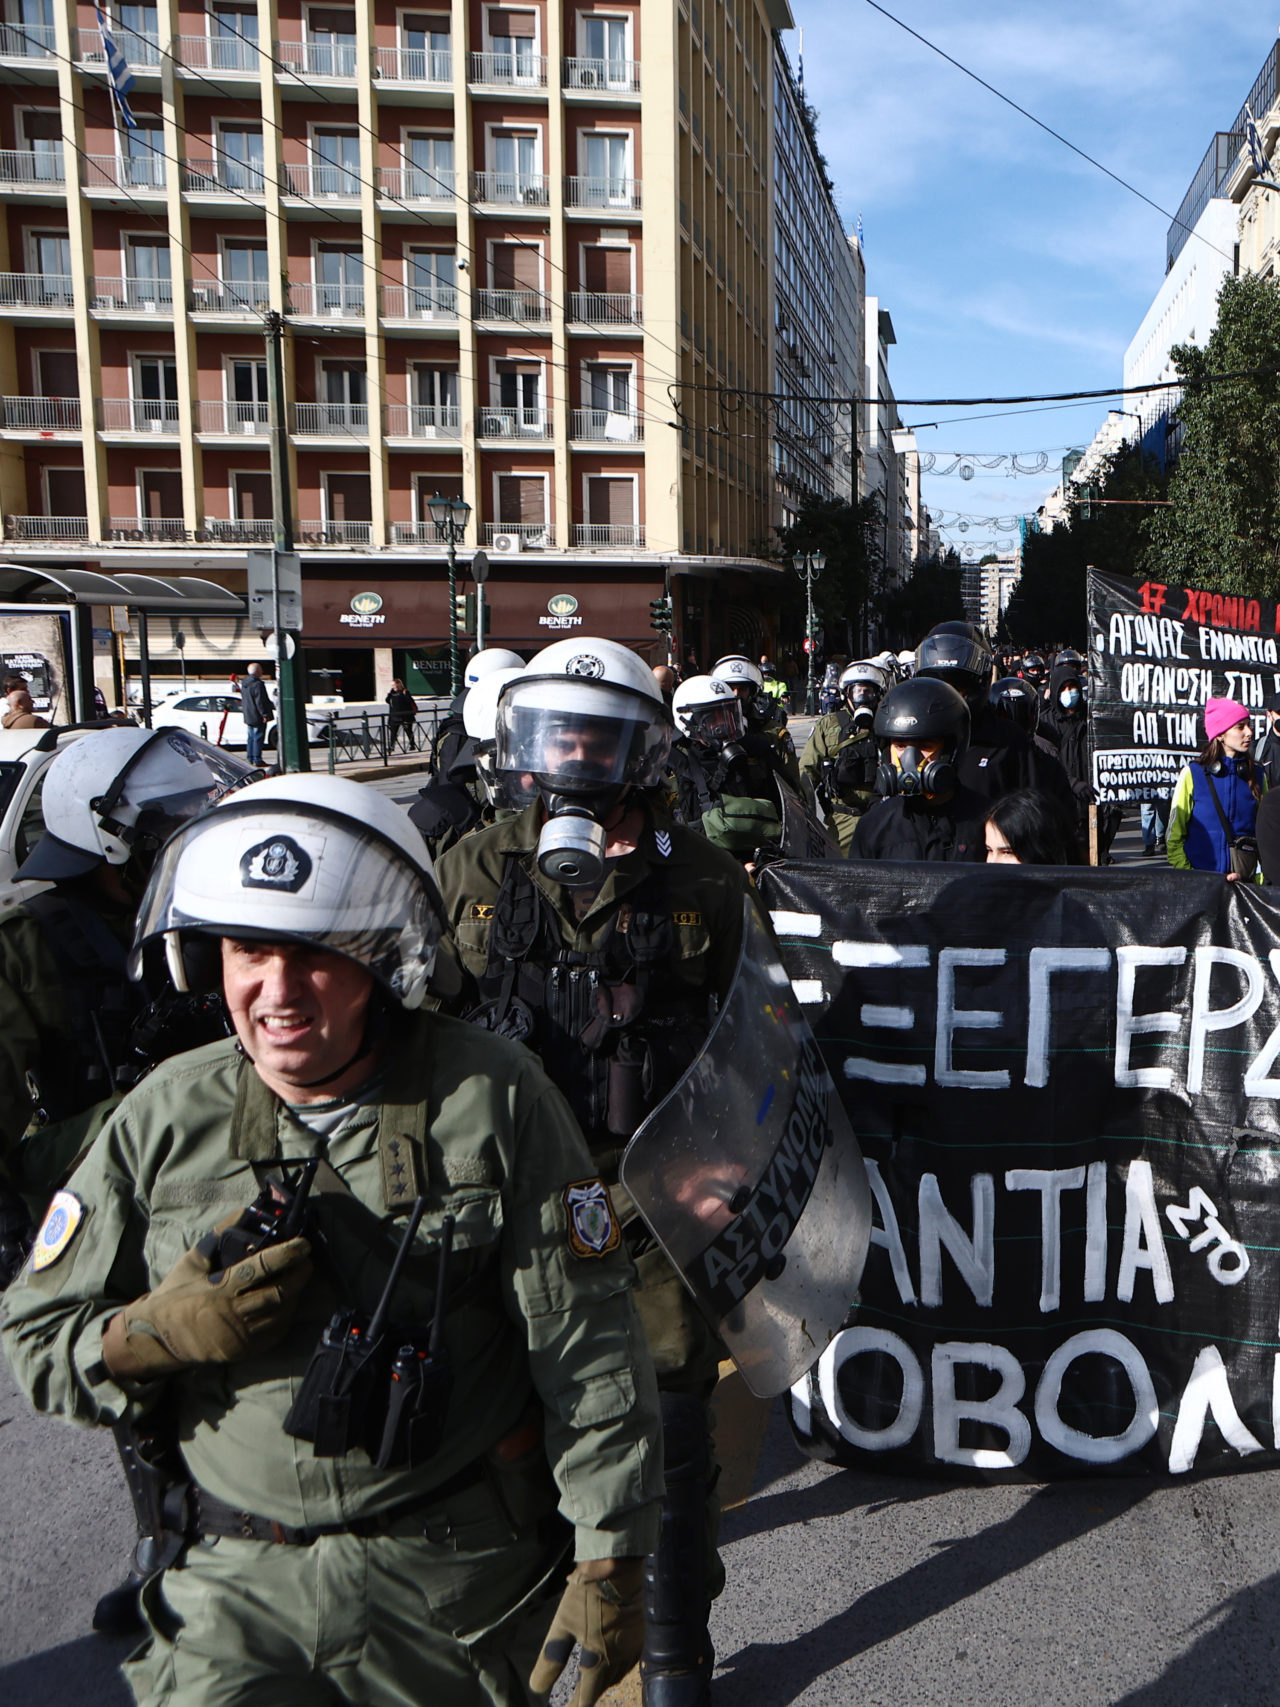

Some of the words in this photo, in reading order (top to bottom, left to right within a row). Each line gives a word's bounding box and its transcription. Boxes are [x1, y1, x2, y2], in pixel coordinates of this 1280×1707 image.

[340, 614, 385, 624] BENETH
[539, 616, 582, 625] BENETH
[1137, 581, 1166, 614] 17
[1181, 588, 1261, 632] ΧΡΟΝΙΑ
[1110, 613, 1190, 660] ΑΓΩΝΑΣ
[1199, 626, 1277, 664] ΕΝΑΝΤΙΑ
[1120, 662, 1212, 706] ΟΡΓΑΝΩΣΗ
[1223, 670, 1264, 708] ΣΤΗ
[1099, 754, 1177, 770] ΠΡΩΤΟΒΟΥΛΙΑ
[724, 1073, 830, 1301] POLICE
